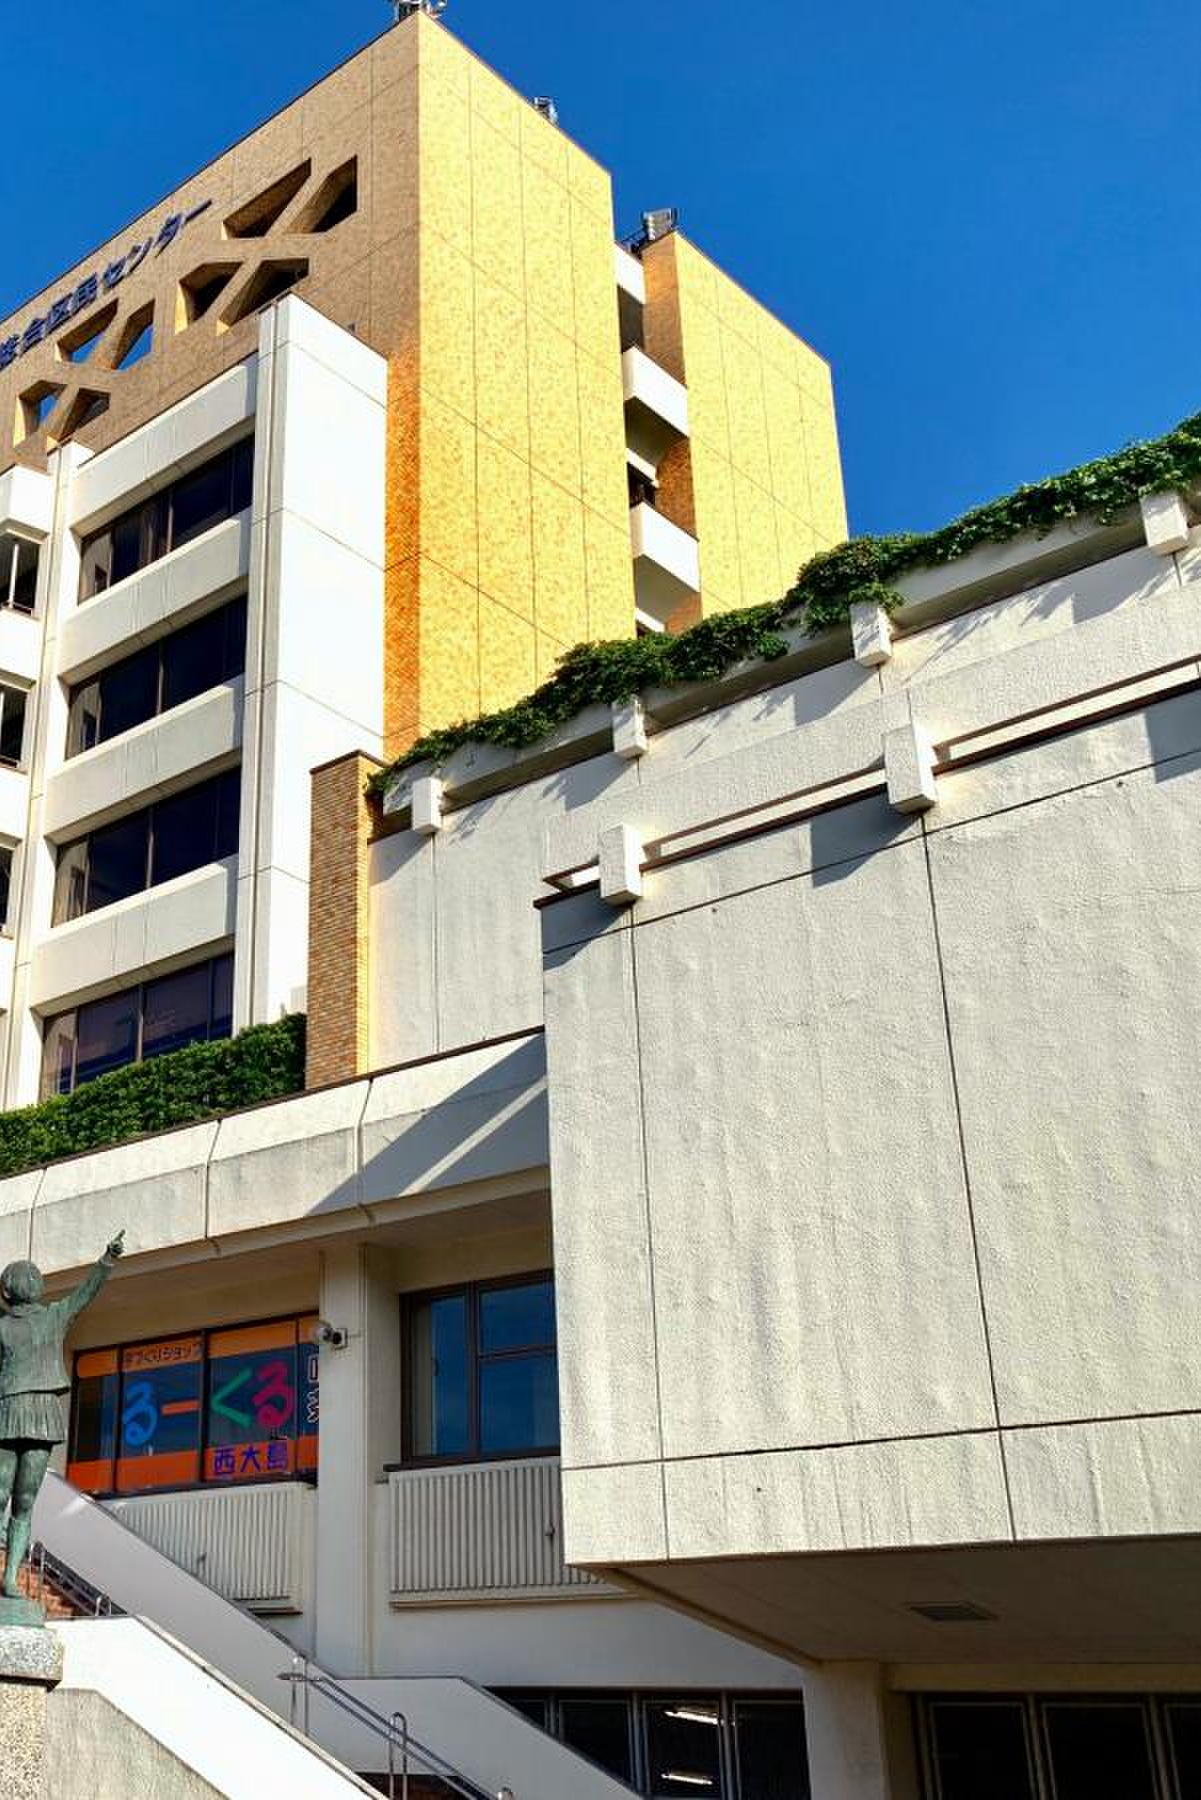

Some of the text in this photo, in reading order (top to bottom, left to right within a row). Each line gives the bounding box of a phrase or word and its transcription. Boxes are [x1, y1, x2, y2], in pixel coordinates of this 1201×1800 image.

[122, 1361, 296, 1446] るーくる
[214, 1442, 288, 1474] 西大島
